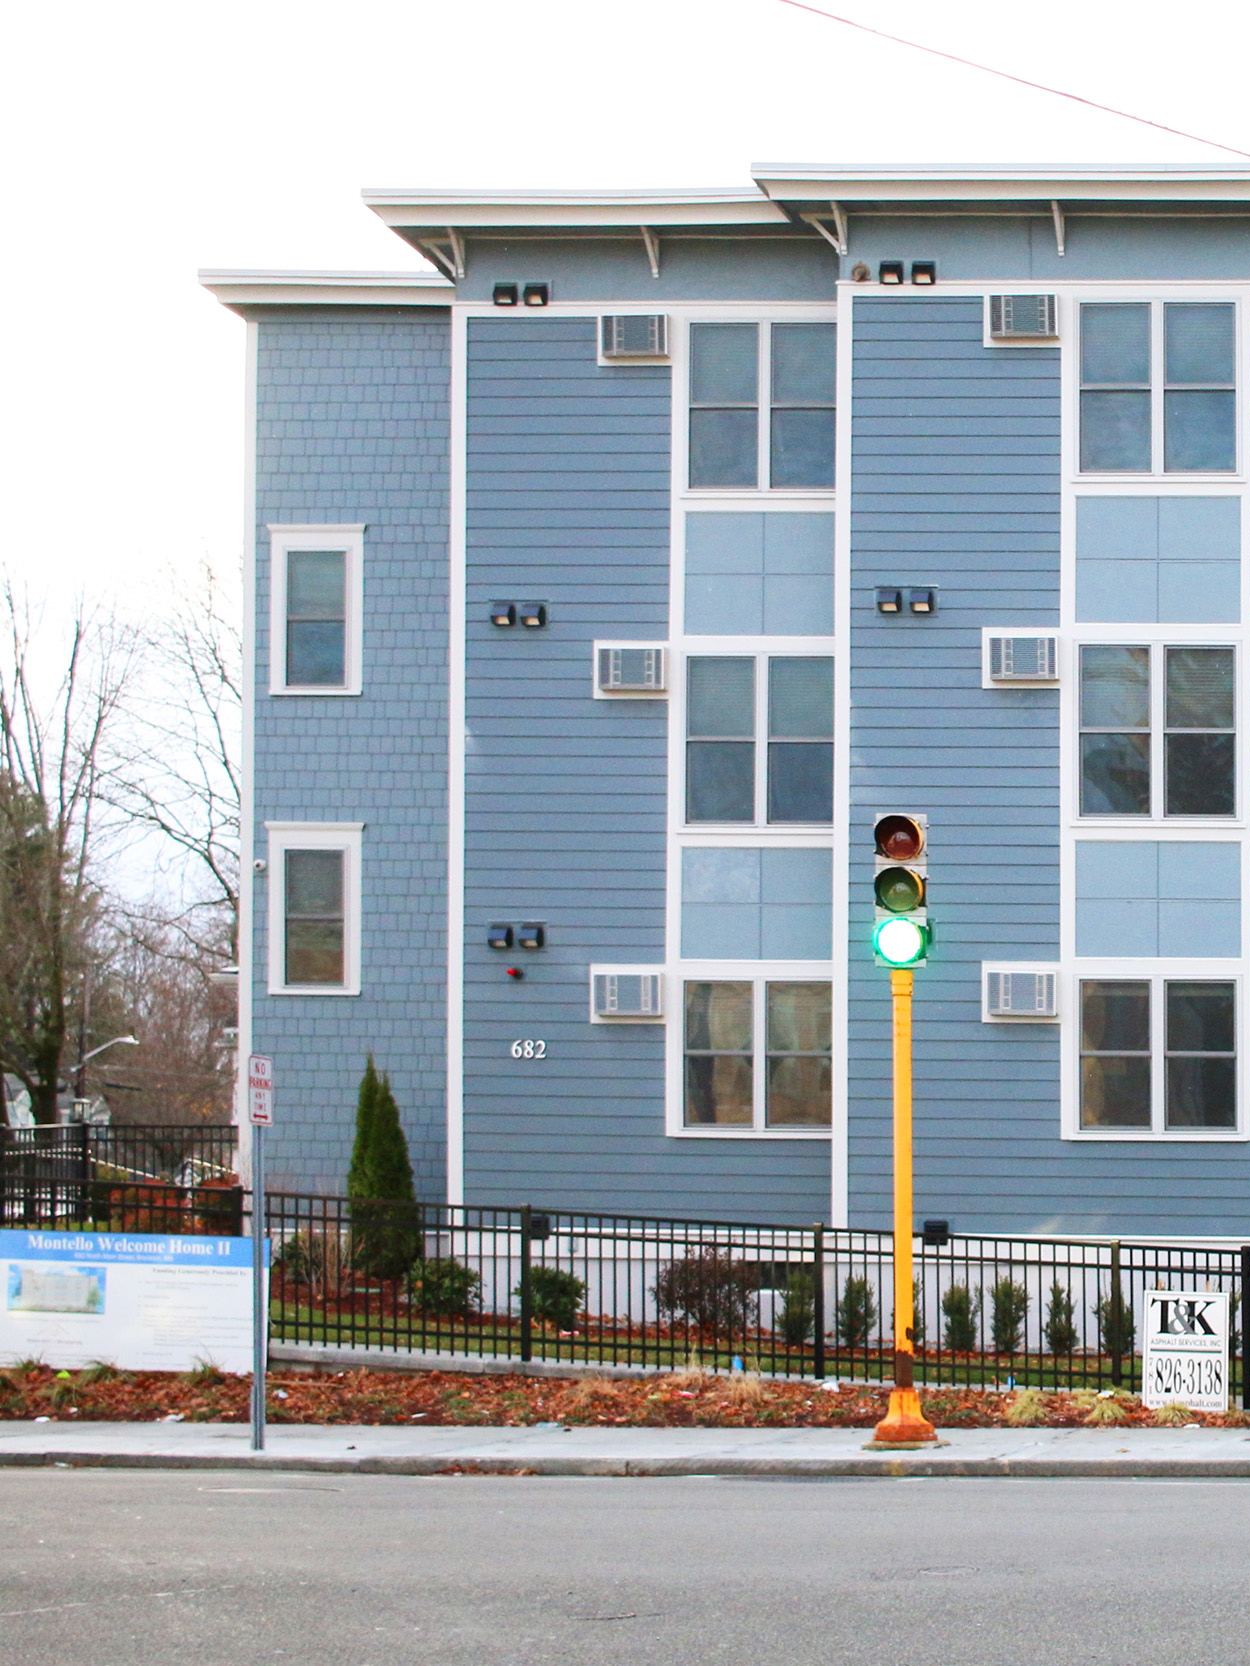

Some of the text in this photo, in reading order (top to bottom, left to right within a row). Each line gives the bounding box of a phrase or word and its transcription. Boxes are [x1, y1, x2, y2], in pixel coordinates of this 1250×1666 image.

[511, 1039, 547, 1059] 682
[255, 1062, 266, 1075] NO
[249, 1077, 272, 1091] PARKING
[255, 1091, 266, 1100] ANY
[254, 1101, 267, 1112] TIME
[28, 1234, 231, 1256] Montello Welcome Home II
[1151, 1298, 1218, 1336] T&K
[1151, 1338, 1177, 1346] ASPHALT
